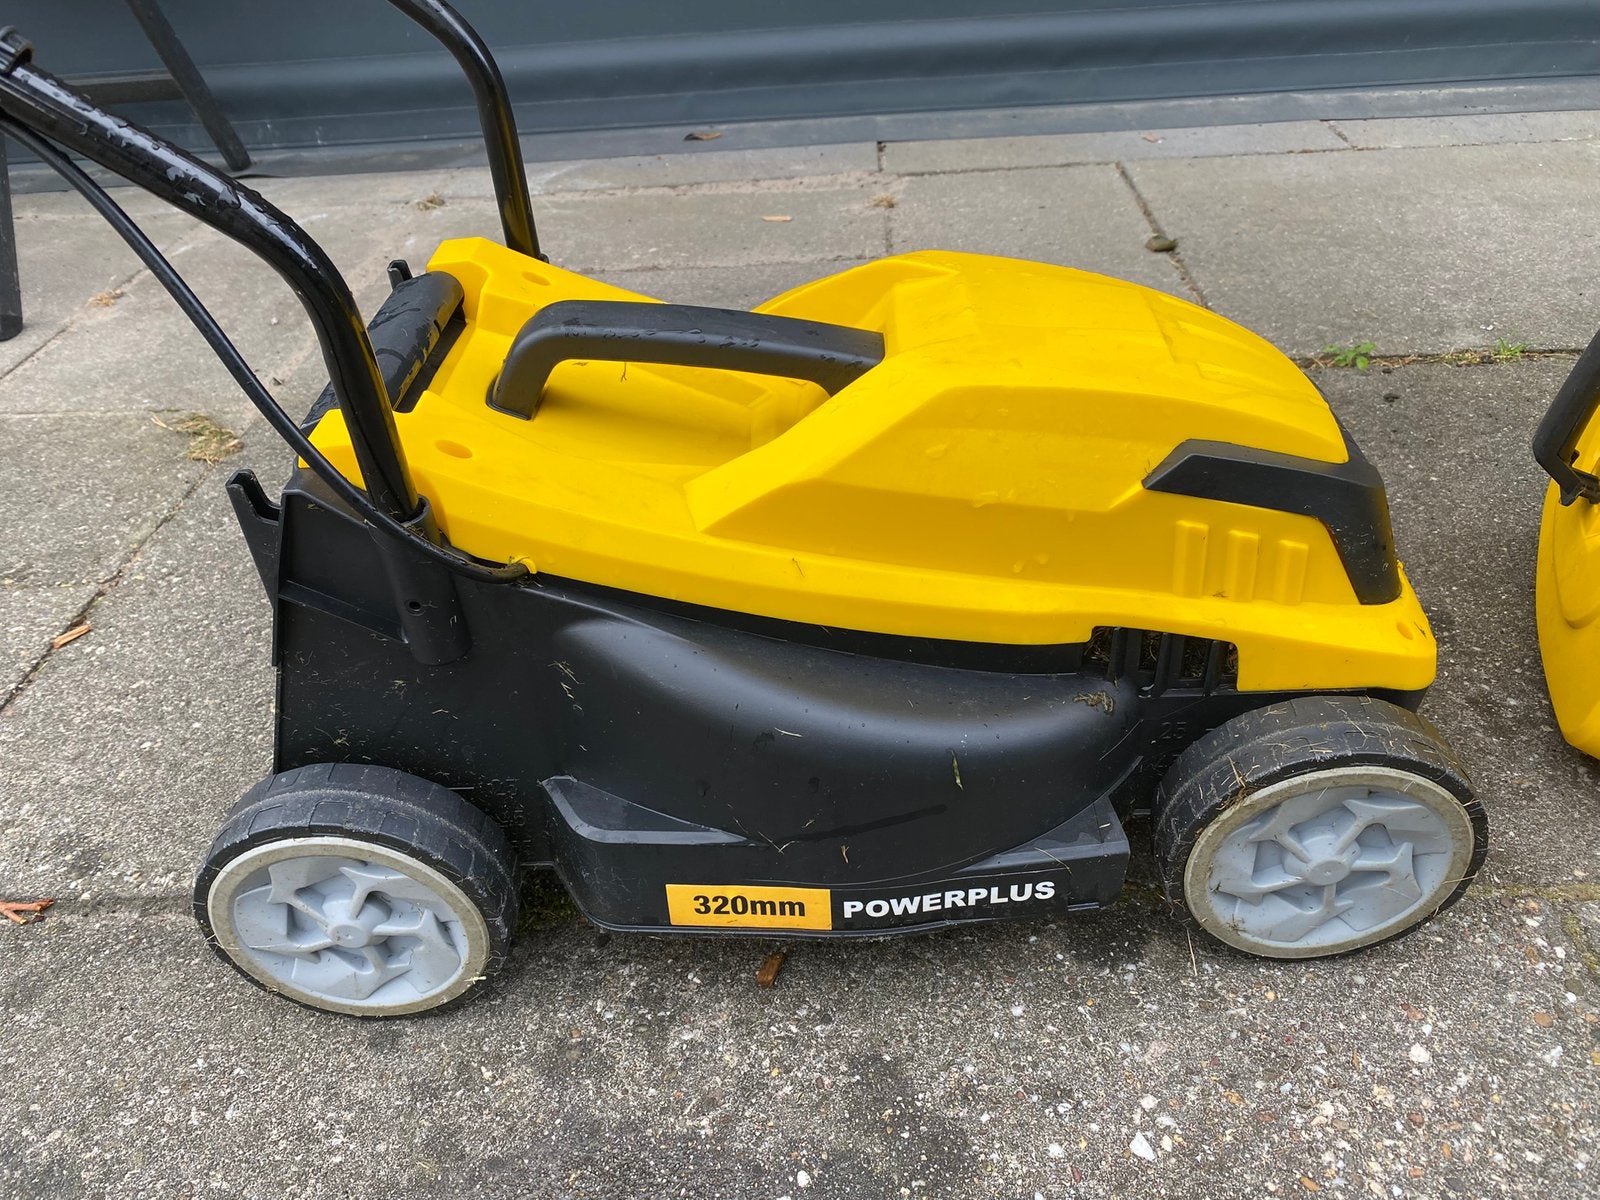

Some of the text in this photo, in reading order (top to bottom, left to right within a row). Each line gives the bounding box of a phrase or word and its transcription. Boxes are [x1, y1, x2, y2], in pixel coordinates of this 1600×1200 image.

[1160, 721, 1187, 740] 25
[693, 895, 806, 917] 320mm
[843, 881, 1056, 918] POWERPLUS
